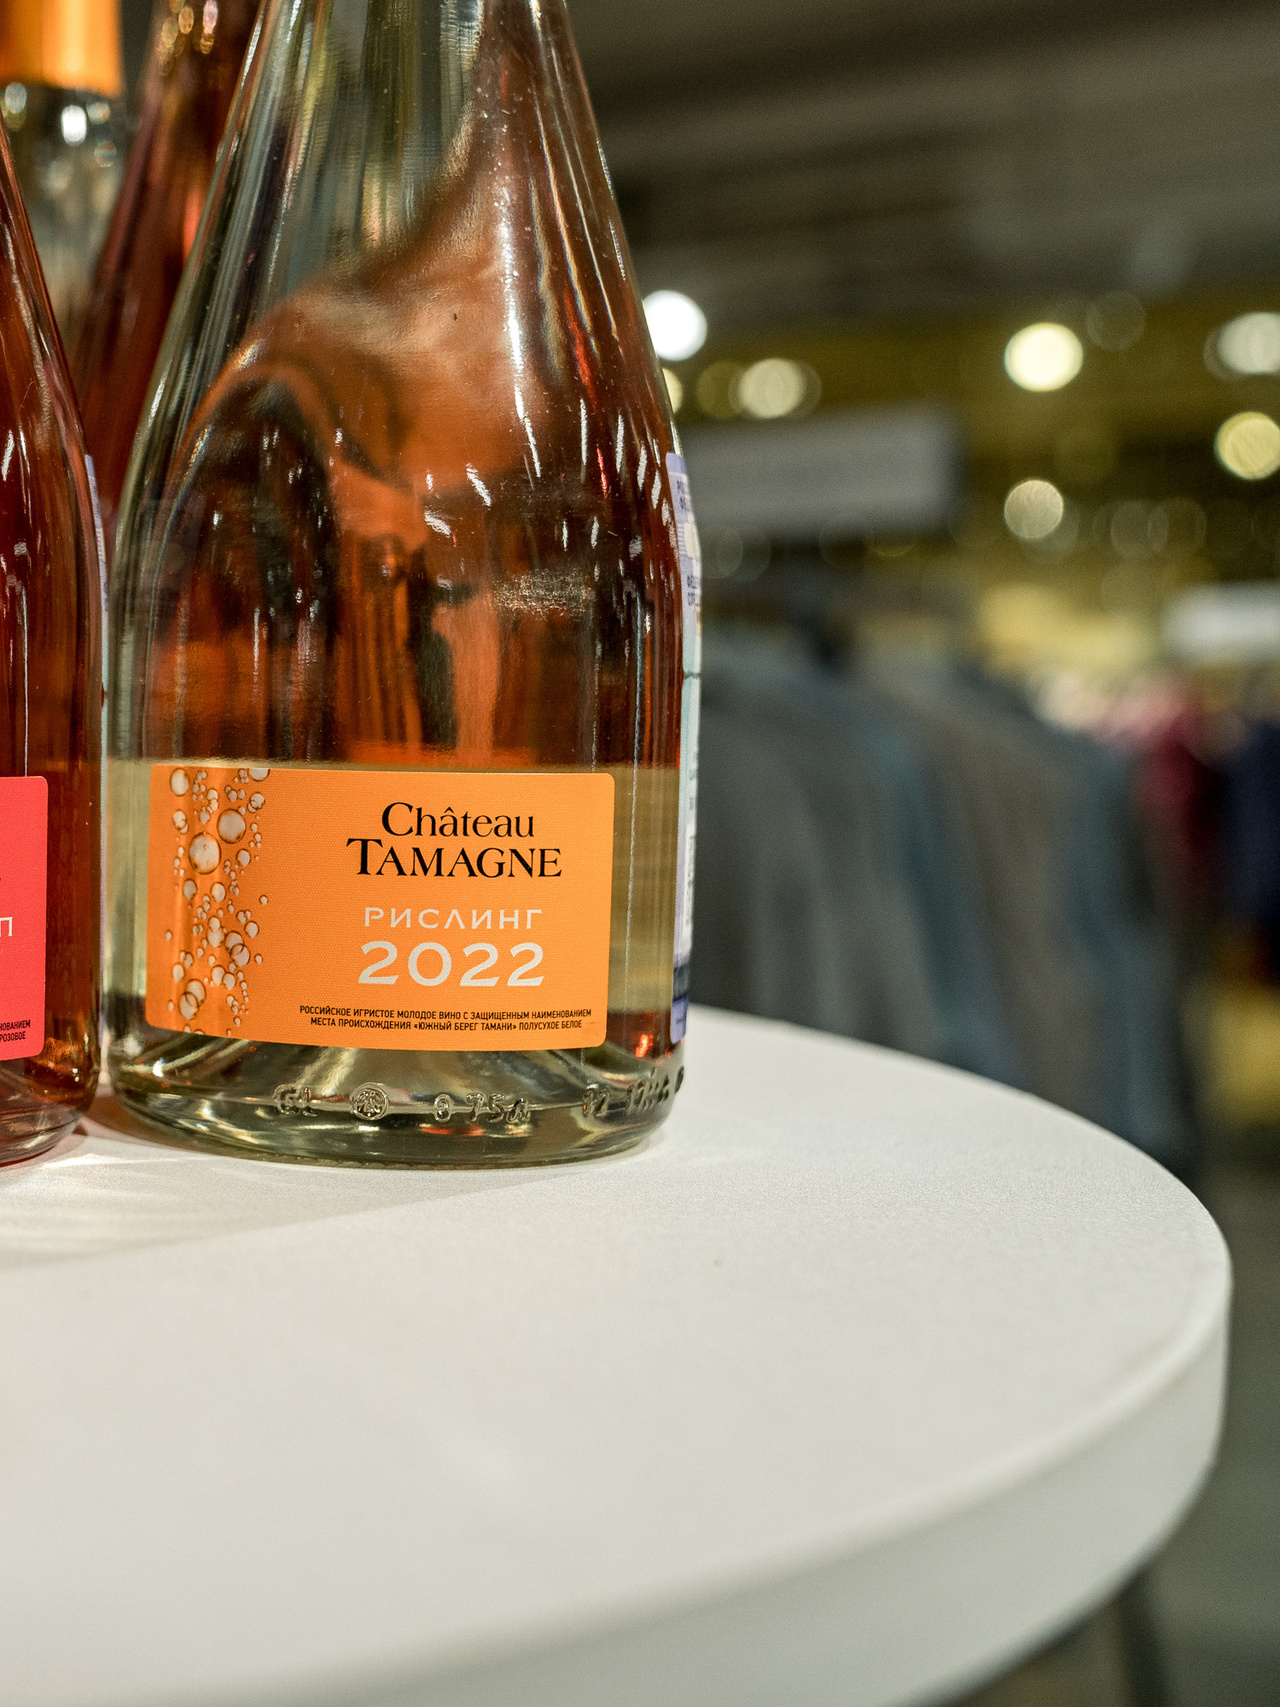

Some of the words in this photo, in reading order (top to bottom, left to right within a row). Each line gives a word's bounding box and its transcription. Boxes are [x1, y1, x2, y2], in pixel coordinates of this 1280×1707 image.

[380, 801, 535, 838] Château
[346, 838, 563, 878] TAMAGNE
[364, 907, 543, 930] РИСЛИНГ
[358, 940, 545, 987] 2022
[299, 1005, 352, 1017] РОССИЙСКОЕ
[353, 1008, 396, 1018] ИГРИСТОЕ
[397, 1010, 437, 1020] МОЛОДОЕ
[439, 1011, 461, 1020] ВИНО
[463, 1011, 469, 1020] С
[470, 1011, 530, 1021] ЗАЩИЩЕННЫМ
[531, 1008, 592, 1019] НАИМЕНОВАНИЕМ
[310, 1016, 336, 1027] МЕСТА
[338, 1018, 412, 1030] ПРОИСХОЖДЕНИЯ
[413, 1020, 452, 1031] «ЮЖНЫЙ
[454, 1022, 479, 1031] БЕРЕГ
[481, 1022, 517, 1031] ТАМАНИ»
[518, 1020, 560, 1031] ПОЛУСУХОЕ
[561, 1019, 583, 1029] БЕЛОЕ
